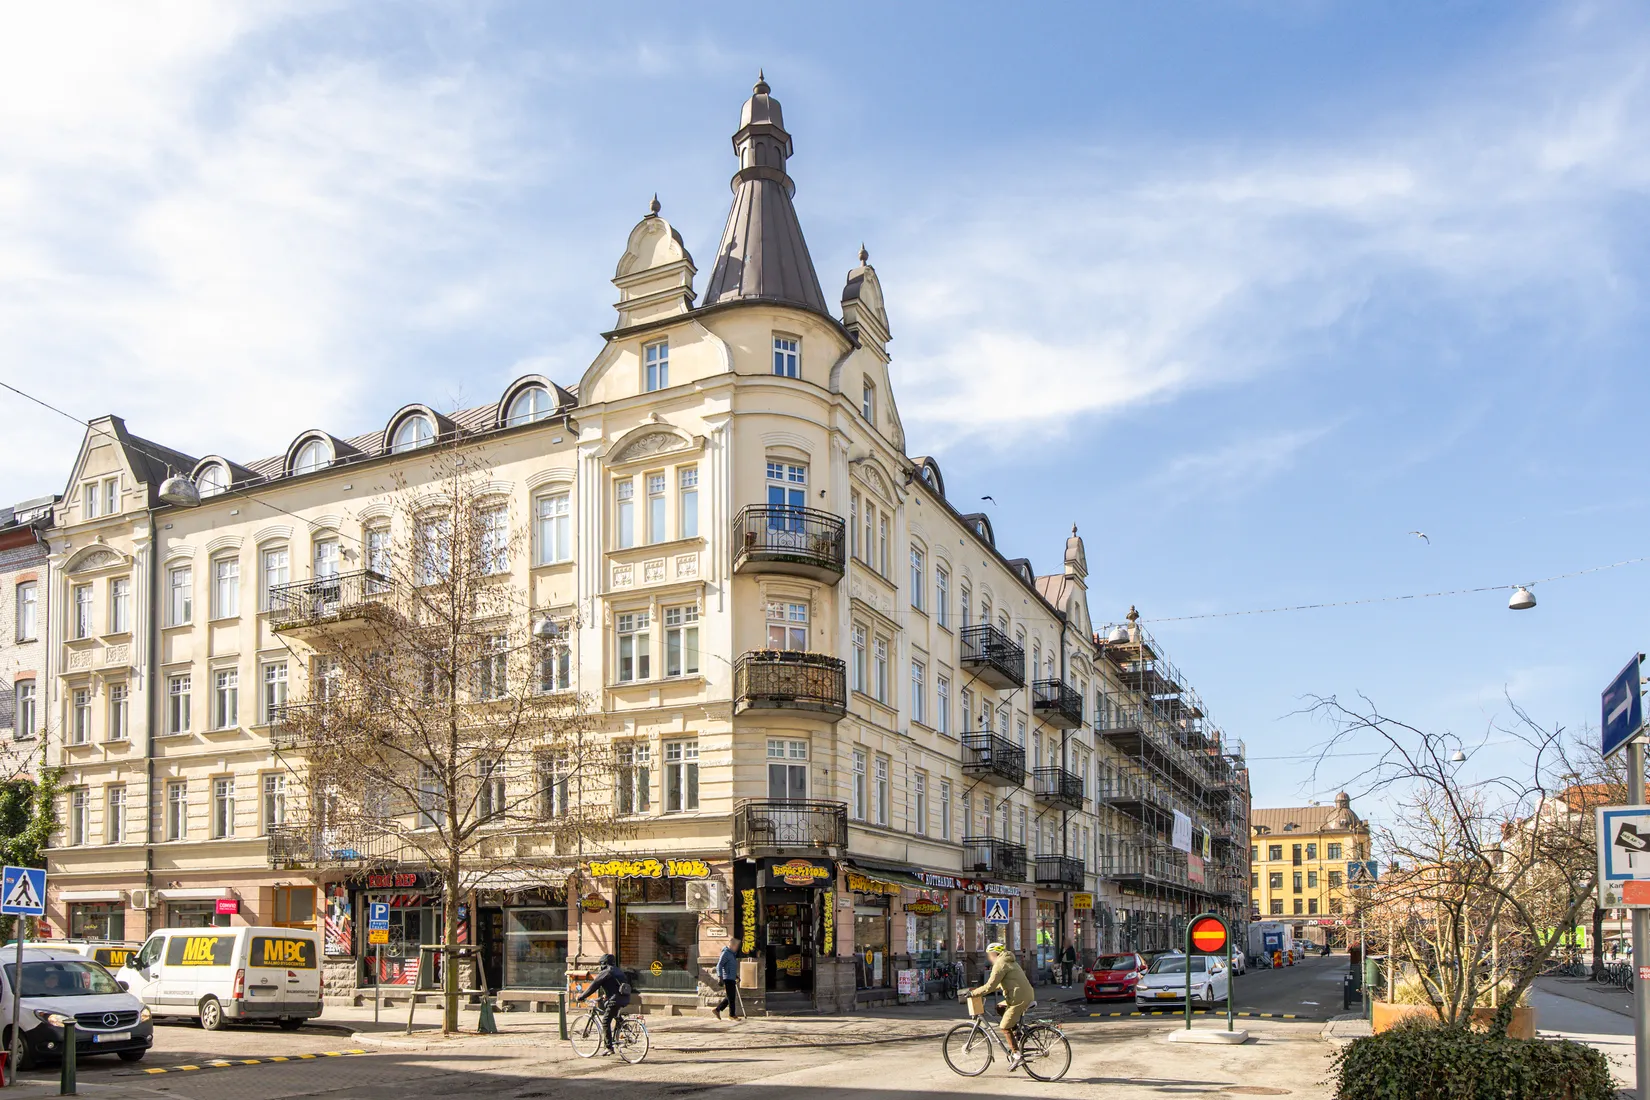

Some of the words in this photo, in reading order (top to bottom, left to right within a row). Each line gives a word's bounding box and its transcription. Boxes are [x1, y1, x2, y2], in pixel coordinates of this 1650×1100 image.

[588, 858, 663, 878] BURGER
[667, 859, 710, 878] MOB
[375, 904, 387, 919] P
[183, 937, 218, 961] MBC
[263, 940, 306, 962] MBC
